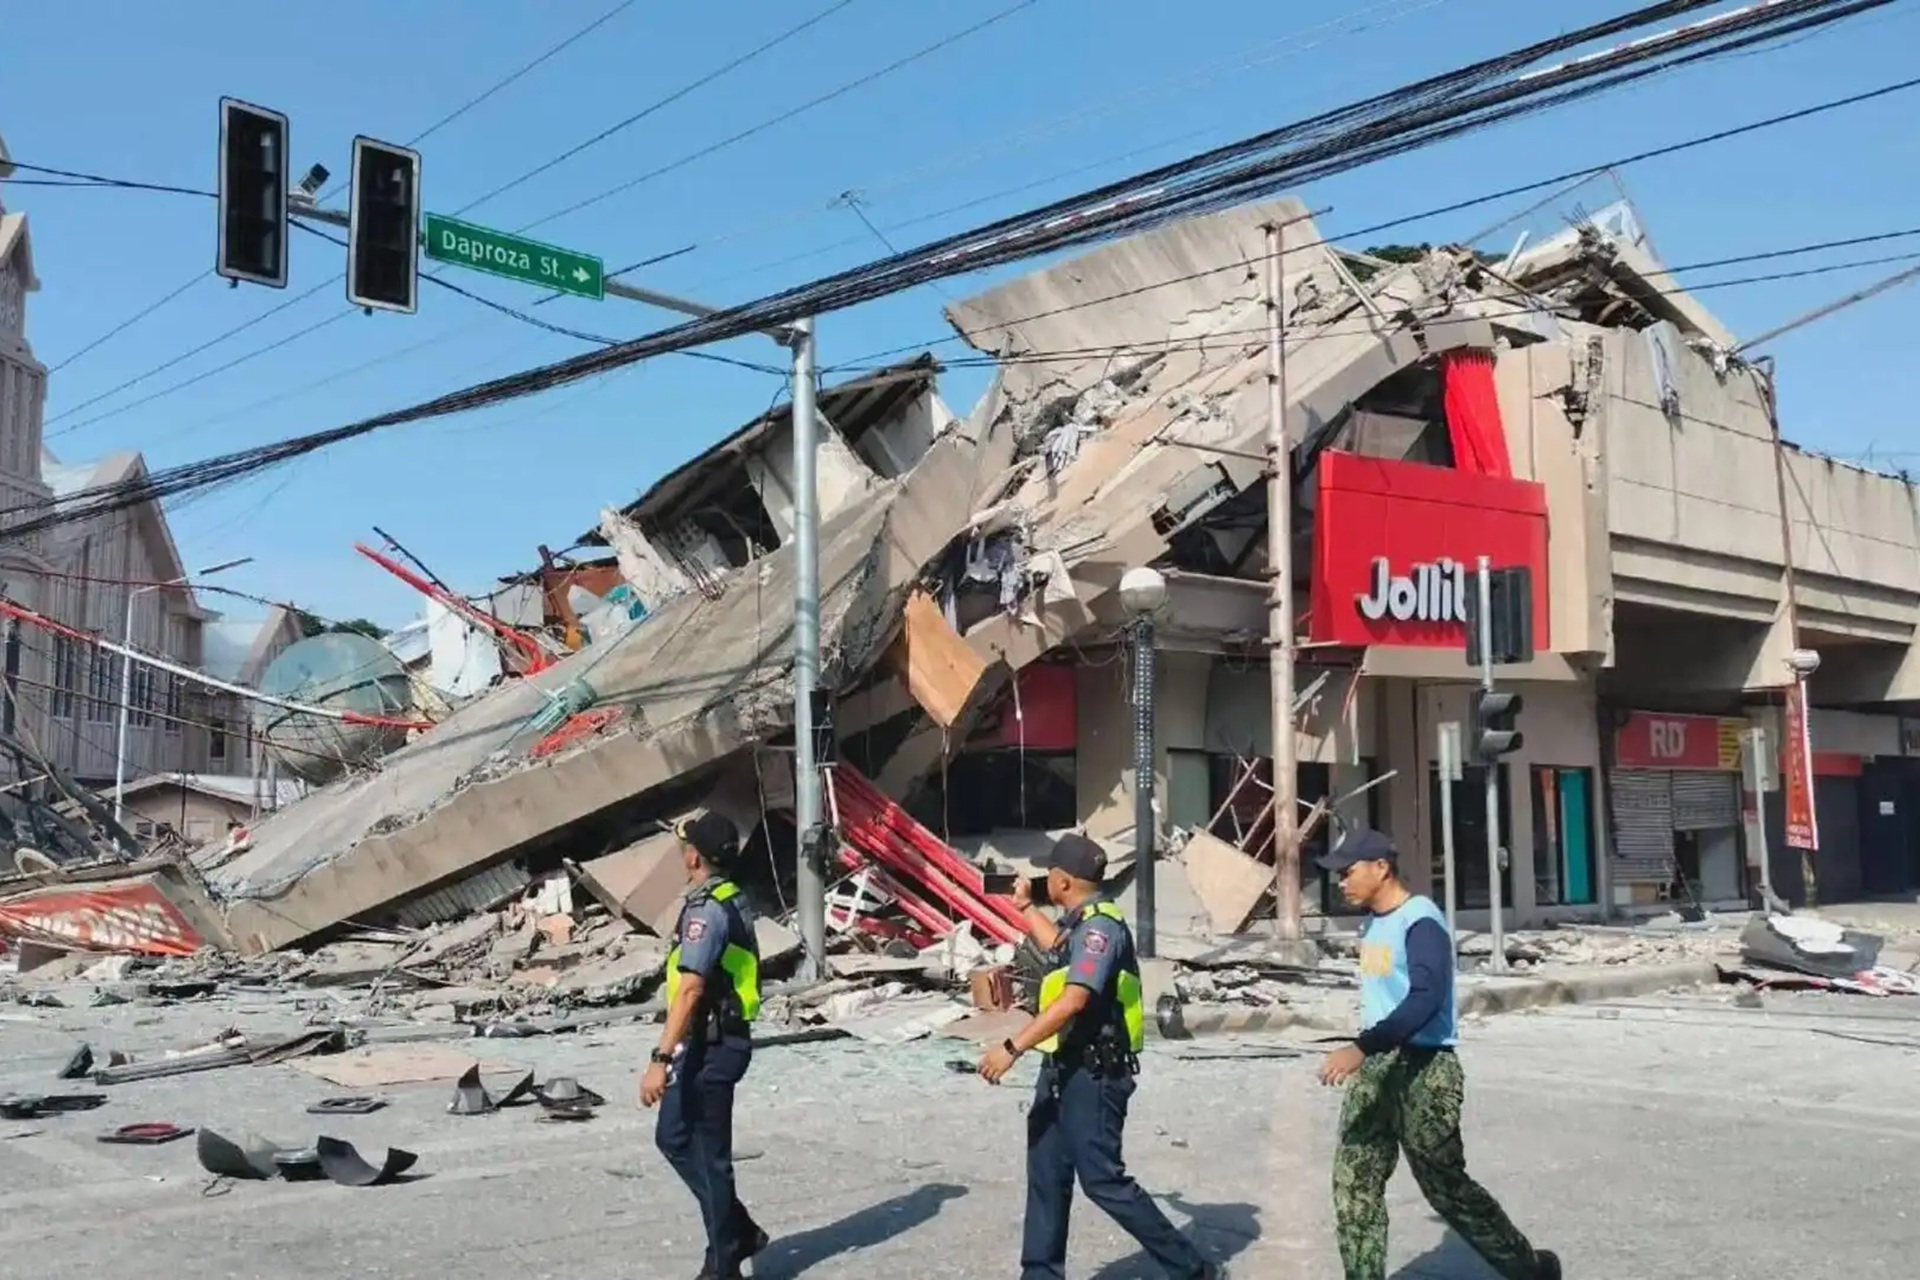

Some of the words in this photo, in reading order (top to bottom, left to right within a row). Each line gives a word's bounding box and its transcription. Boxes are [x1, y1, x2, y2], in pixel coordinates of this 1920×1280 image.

[442, 230, 530, 269] Daproza
[540, 256, 565, 280] St.
[1650, 720, 1685, 758] RD
